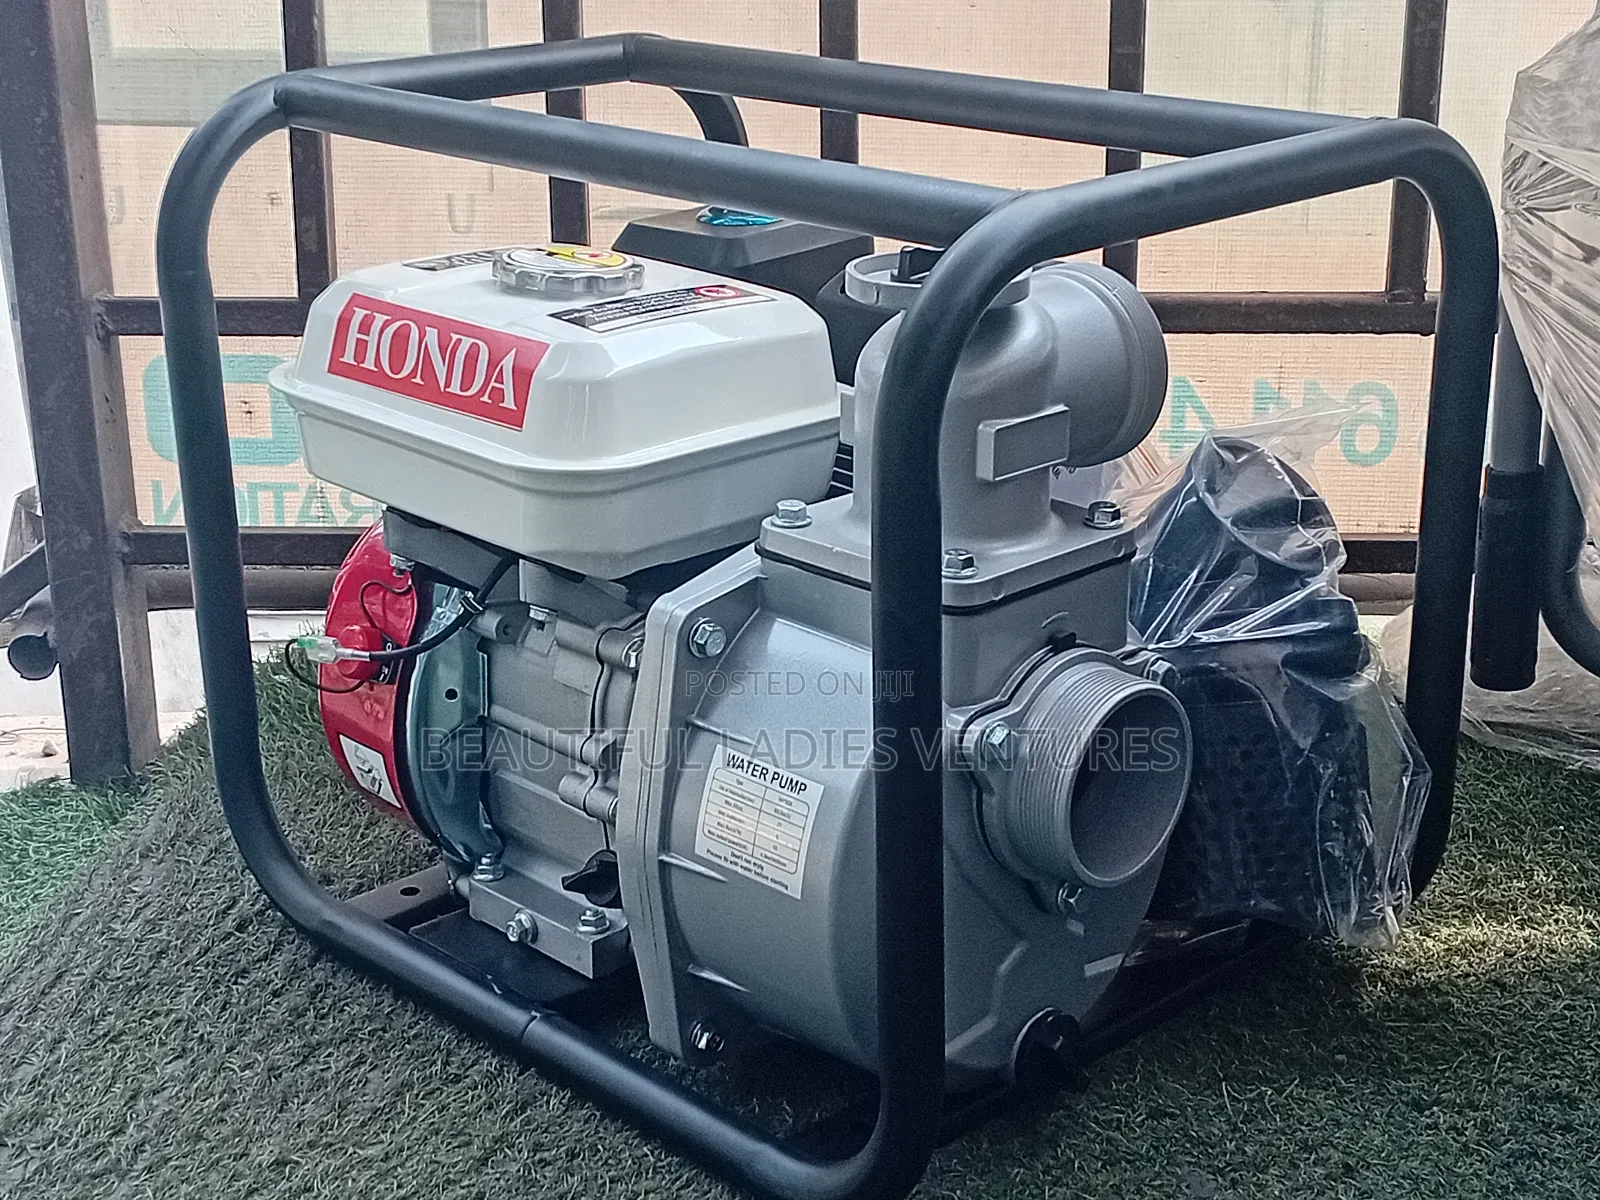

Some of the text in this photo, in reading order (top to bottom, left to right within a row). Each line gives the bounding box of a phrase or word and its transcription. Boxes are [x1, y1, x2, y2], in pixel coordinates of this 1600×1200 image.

[339, 306, 518, 411] HONDA
[727, 752, 769, 782] WATER
[770, 771, 808, 796] PUMP
